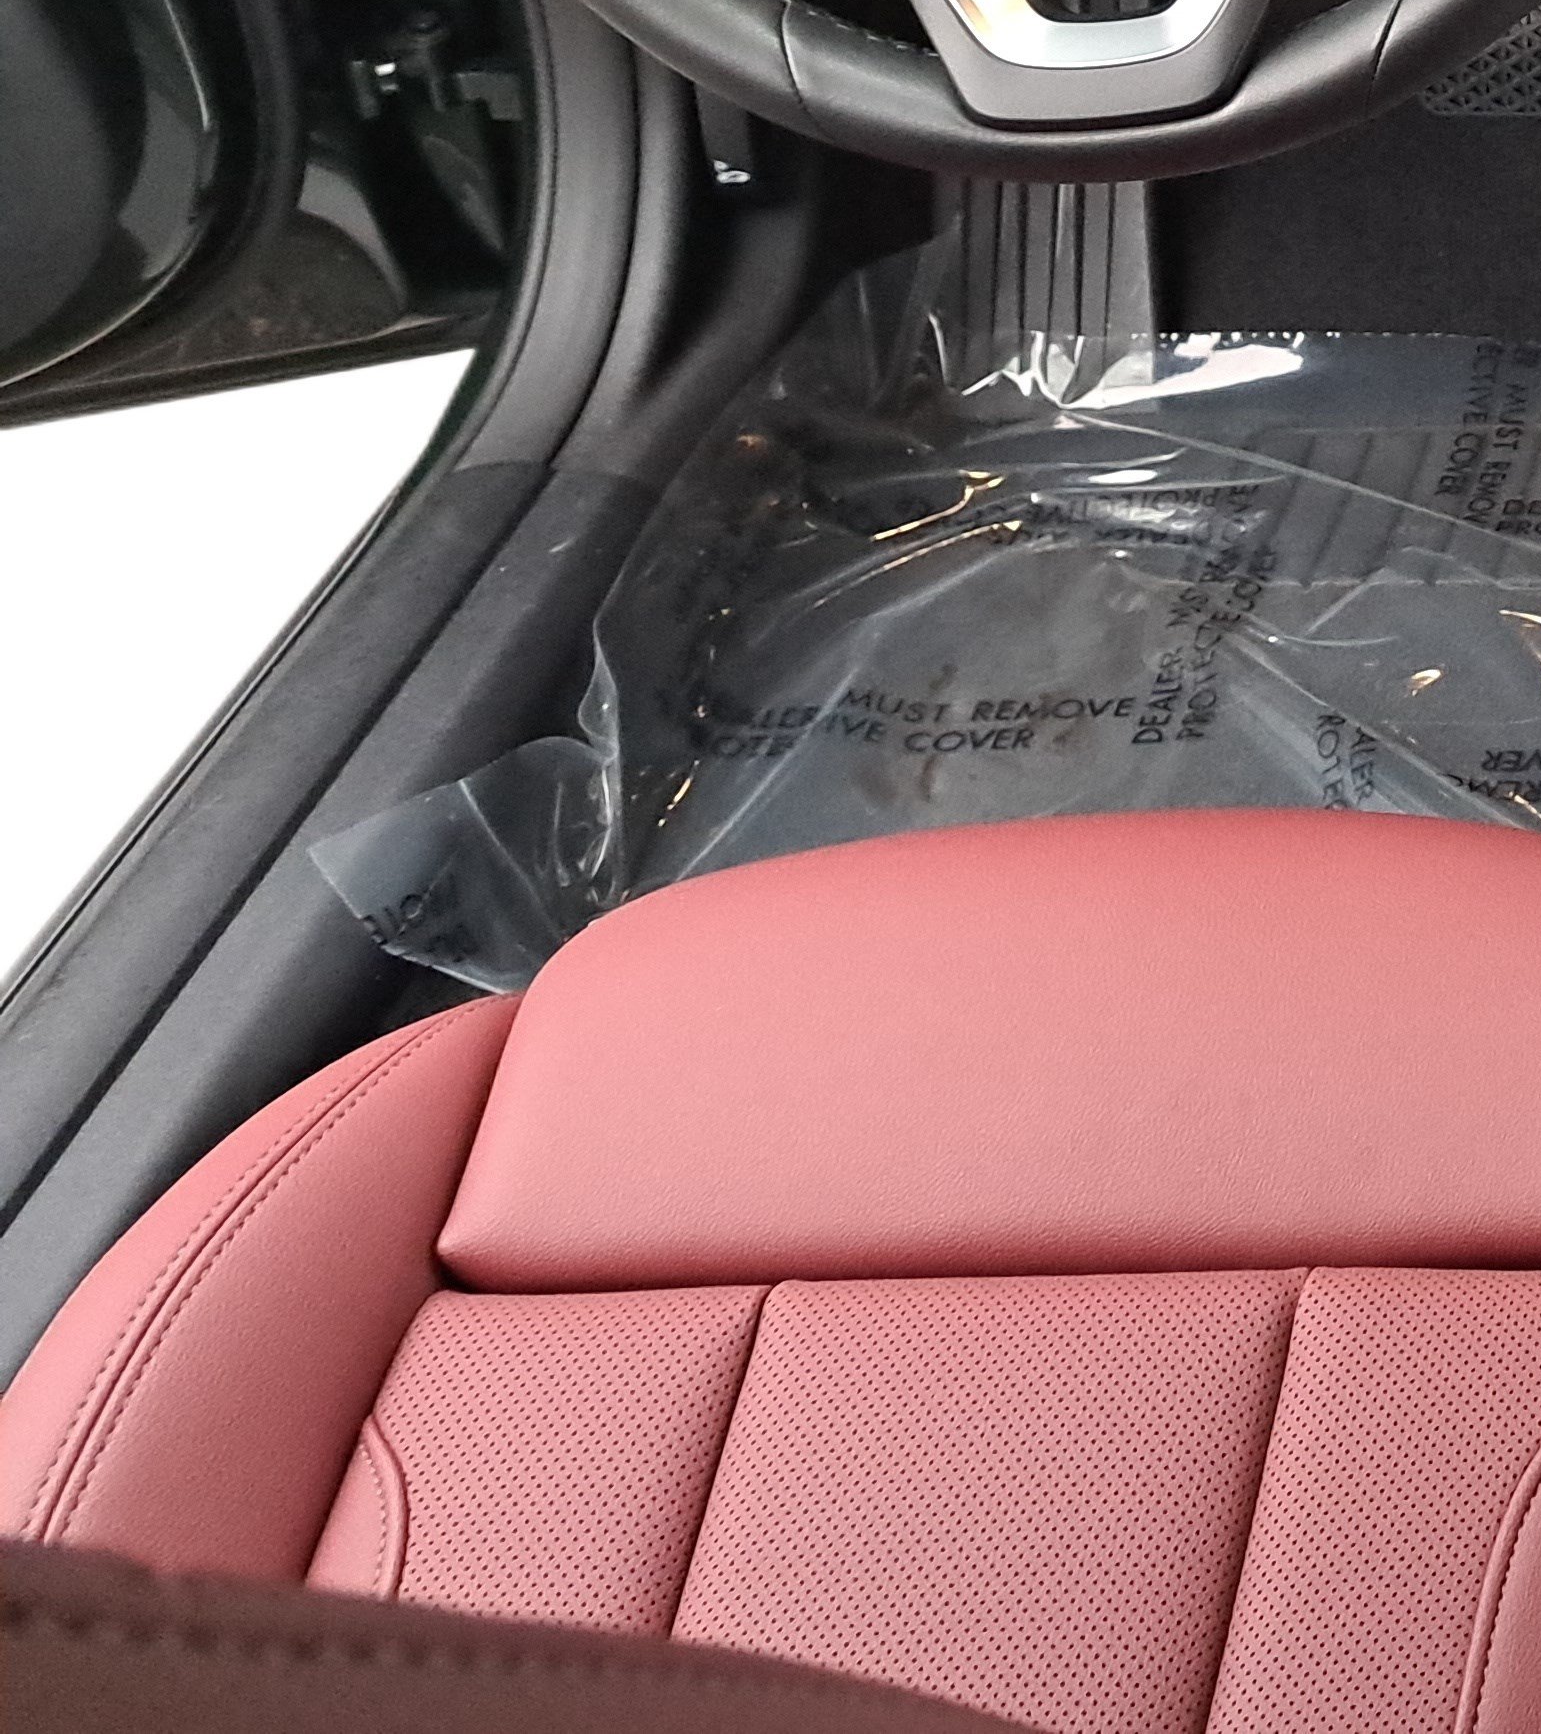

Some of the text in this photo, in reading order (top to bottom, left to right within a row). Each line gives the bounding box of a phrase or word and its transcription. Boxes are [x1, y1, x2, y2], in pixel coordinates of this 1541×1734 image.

[838, 687, 951, 725] MUST
[970, 692, 1137, 724] REMOVE
[904, 727, 1036, 754] COVER
